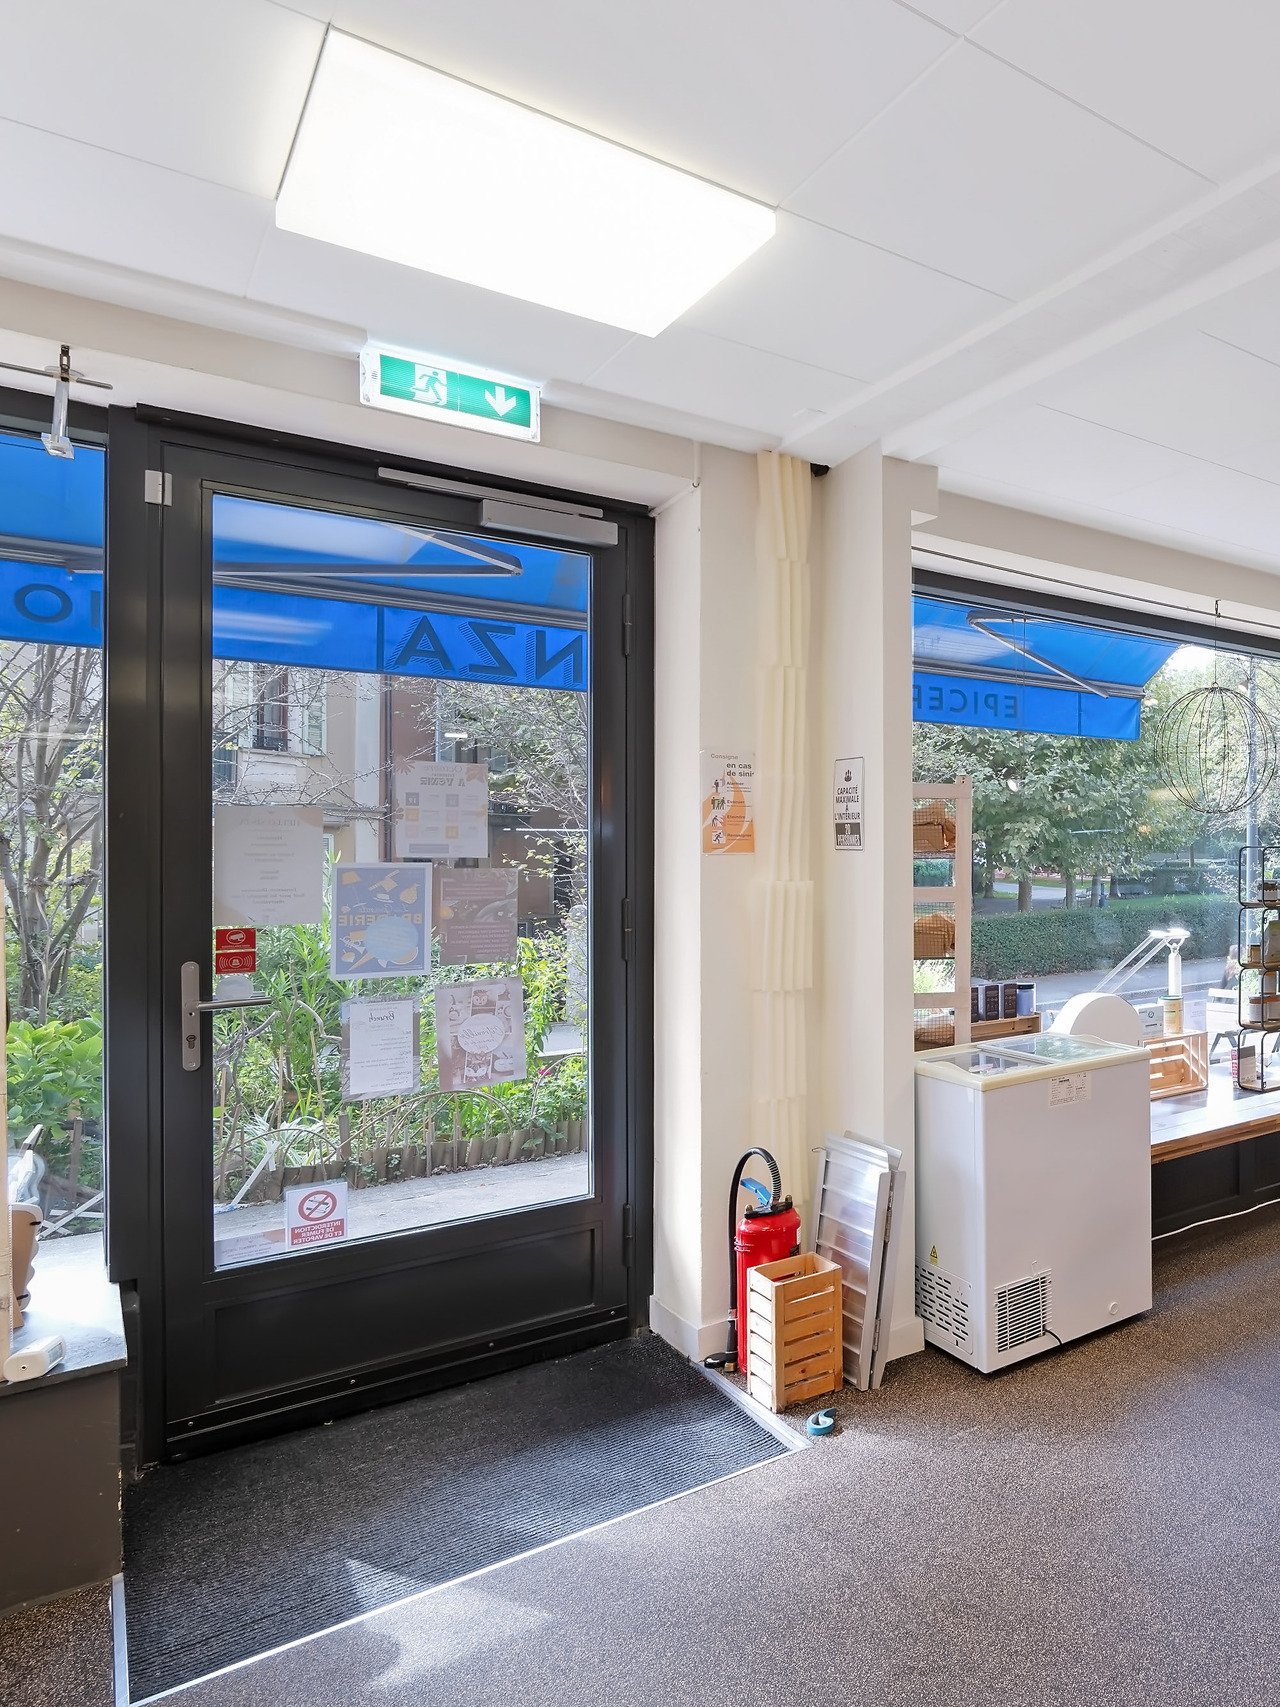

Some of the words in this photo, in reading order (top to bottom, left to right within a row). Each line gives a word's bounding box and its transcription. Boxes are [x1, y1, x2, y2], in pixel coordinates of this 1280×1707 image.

[710, 752, 739, 761] Consigne
[726, 769, 736, 778] de
[738, 770, 755, 778] sini
[836, 785, 859, 795] CAPACITÉ
[835, 795, 860, 804] MAXIMALE
